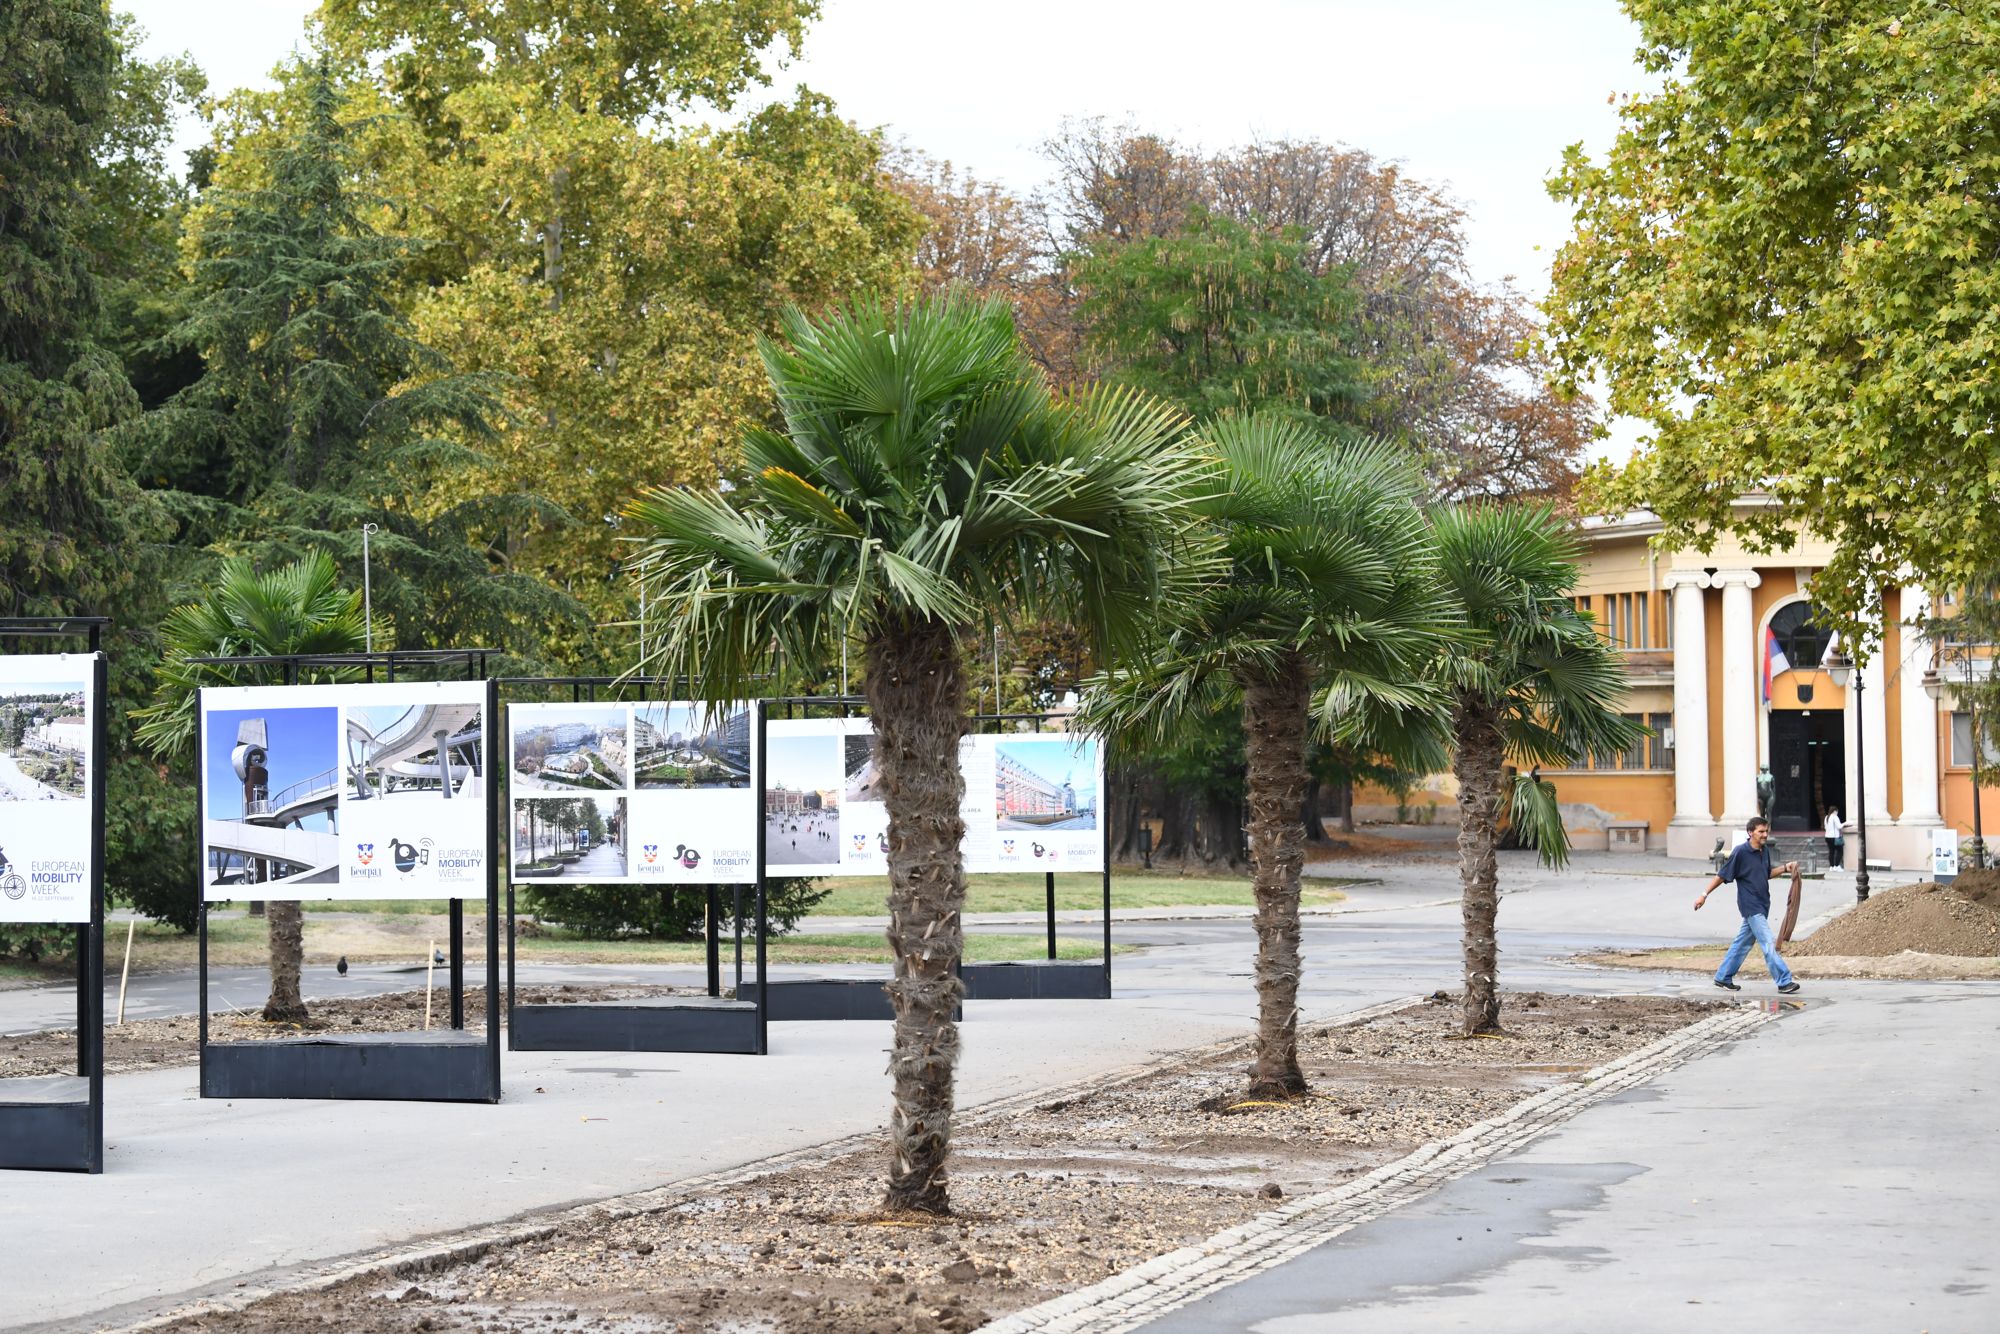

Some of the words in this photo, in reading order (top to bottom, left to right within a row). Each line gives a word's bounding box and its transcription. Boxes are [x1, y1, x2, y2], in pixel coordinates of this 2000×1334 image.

[438, 849, 483, 858] EUROPEAN
[712, 850, 752, 858] EUROPEAN
[31, 861, 85, 872] EUROPEAN
[438, 859, 482, 868] MOBILITY
[713, 858, 750, 866] MOBILITY
[438, 868, 463, 878] WEEK
[712, 866, 734, 874] WEEK
[31, 873, 83, 883] MOBILITY
[31, 884, 60, 895] WEEK
